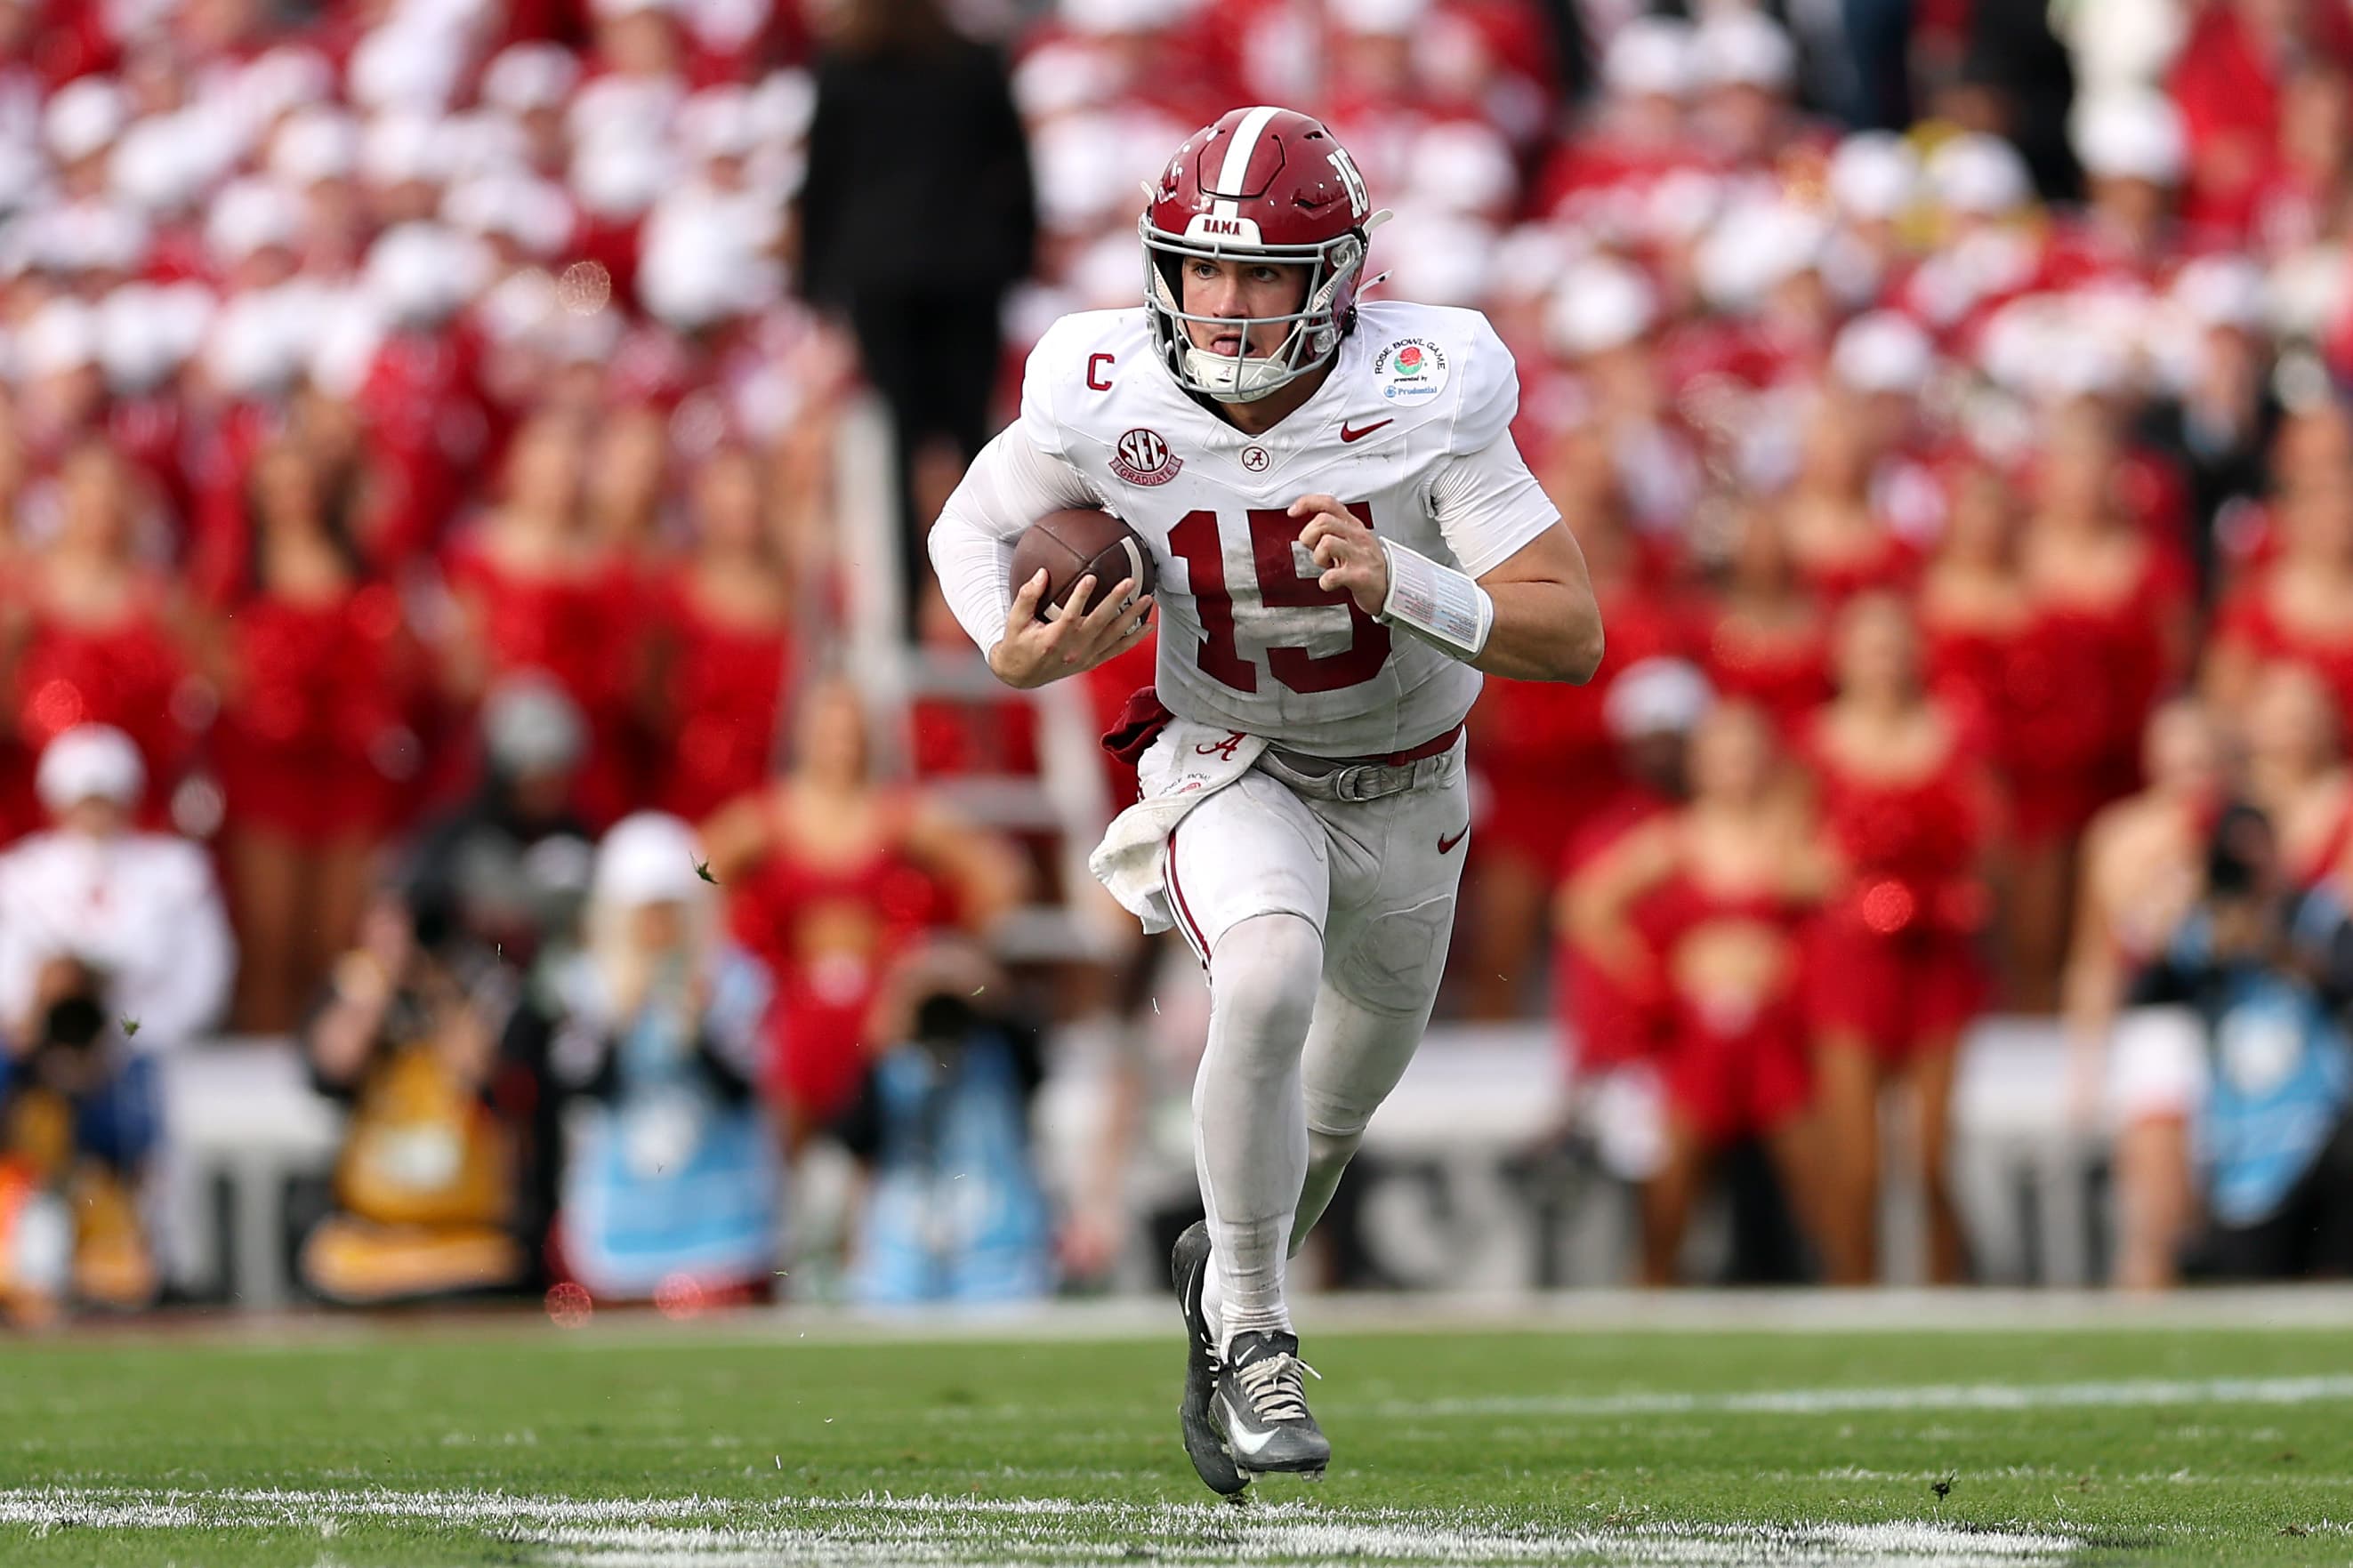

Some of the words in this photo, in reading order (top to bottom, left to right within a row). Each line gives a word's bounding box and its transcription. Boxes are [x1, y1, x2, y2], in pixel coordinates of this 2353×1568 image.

[1326, 148, 1369, 219] 15
[1203, 219, 1240, 236] BAMA
[1087, 352, 1115, 391] C
[1374, 347, 1392, 374] ROSE
[1392, 338, 1424, 349] BOWL
[1427, 342, 1446, 370] GAME
[1398, 386, 1438, 395] Prudential
[1120, 430, 1166, 470] SEC
[1120, 468, 1174, 485] GRADUATE
[1167, 501, 1392, 694] 15
